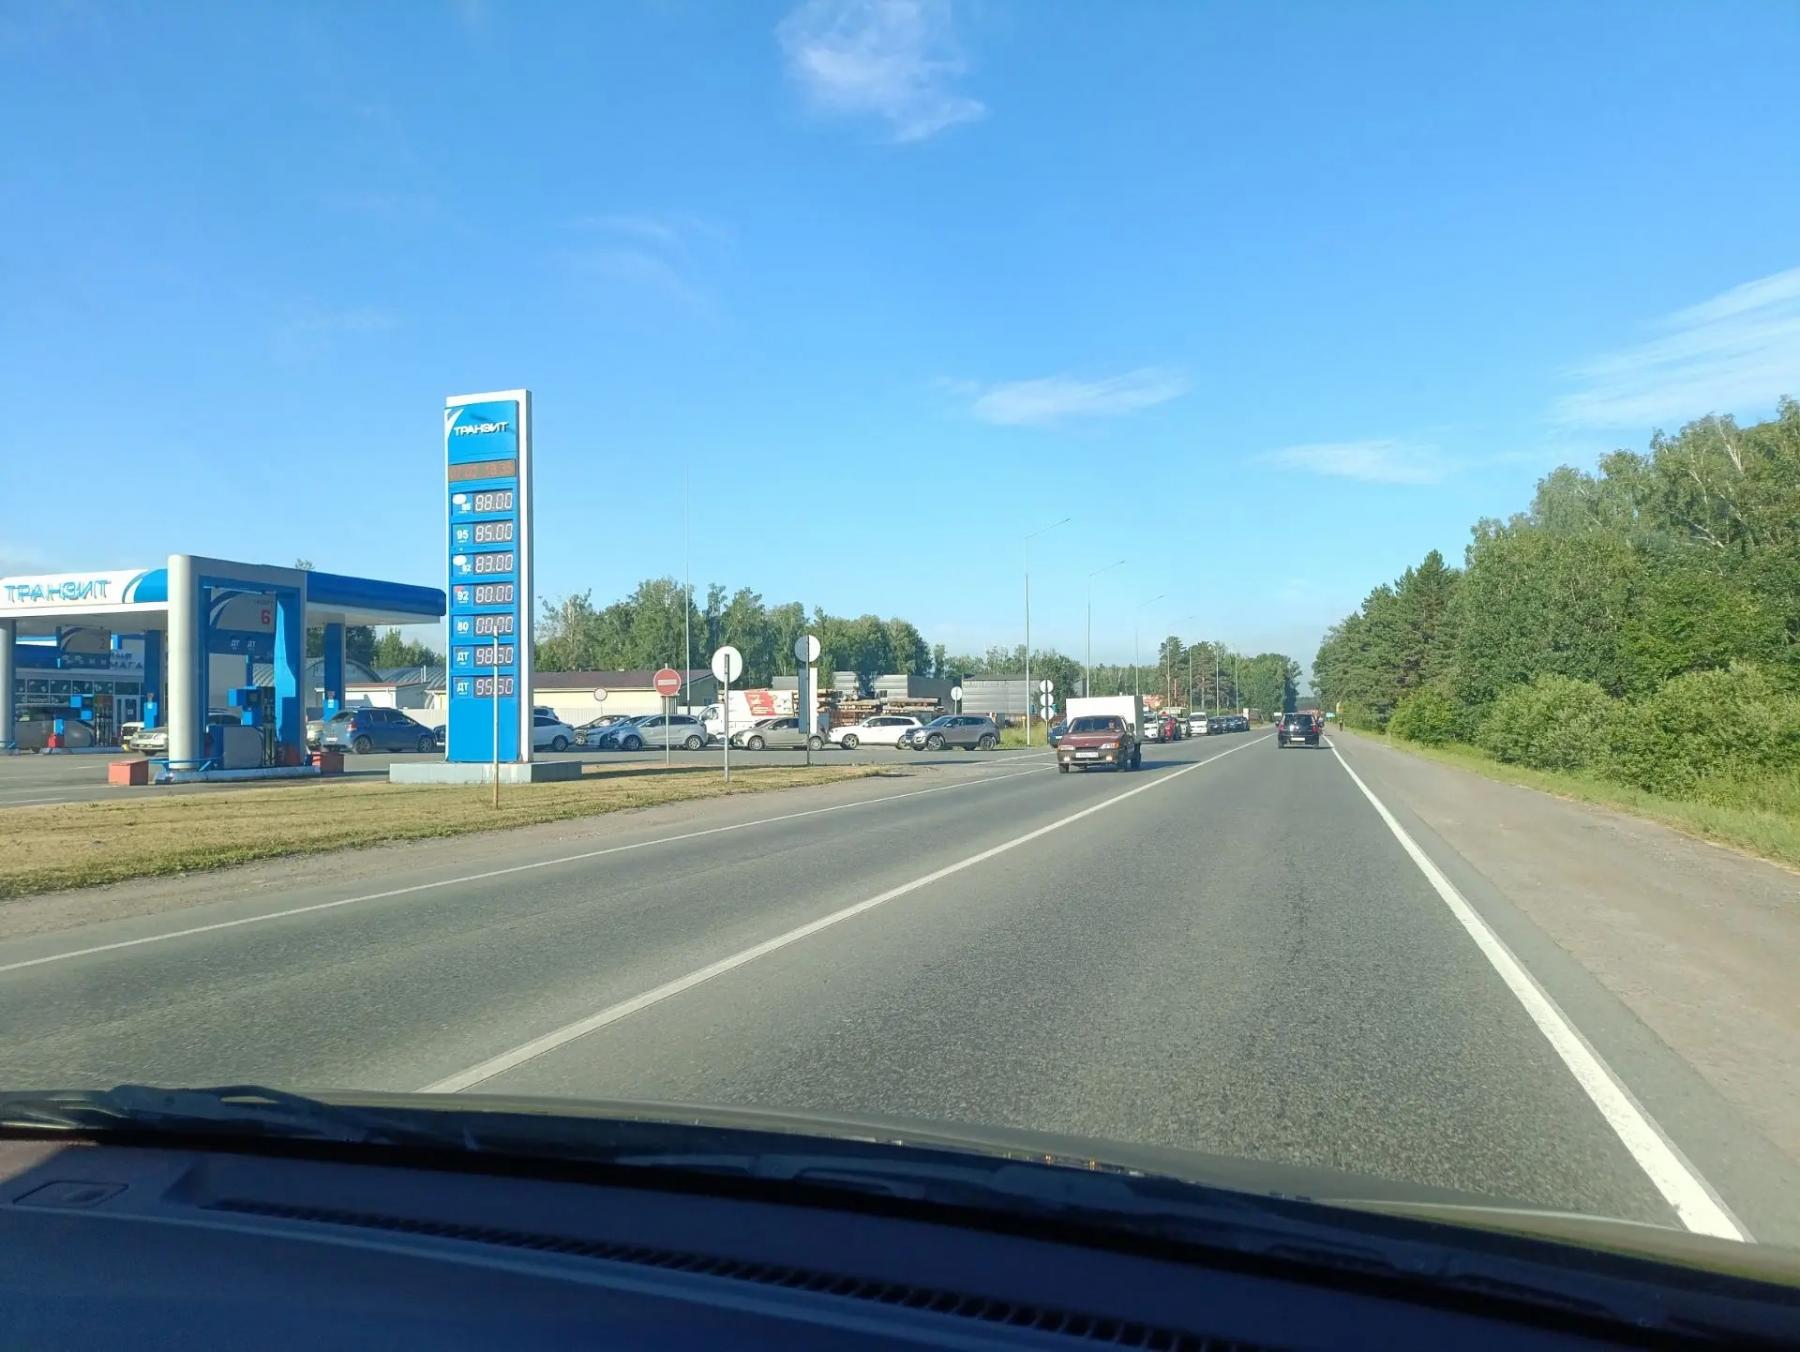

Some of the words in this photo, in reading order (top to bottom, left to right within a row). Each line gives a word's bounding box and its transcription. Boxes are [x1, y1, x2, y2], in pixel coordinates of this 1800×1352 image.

[453, 421, 509, 436] ТРАНЗИТ
[475, 492, 513, 512] 88.00
[456, 529, 469, 540] 95
[475, 523, 513, 542] 85.00
[475, 554, 513, 573] 83.00
[4, 579, 112, 603] ТРАНЗИТ
[456, 591, 469, 601] 92
[475, 585, 513, 603] 80.00
[260, 609, 271, 625] 6
[456, 622, 469, 631] 80
[456, 651, 469, 662] ДТ
[456, 682, 469, 693] ДТ
